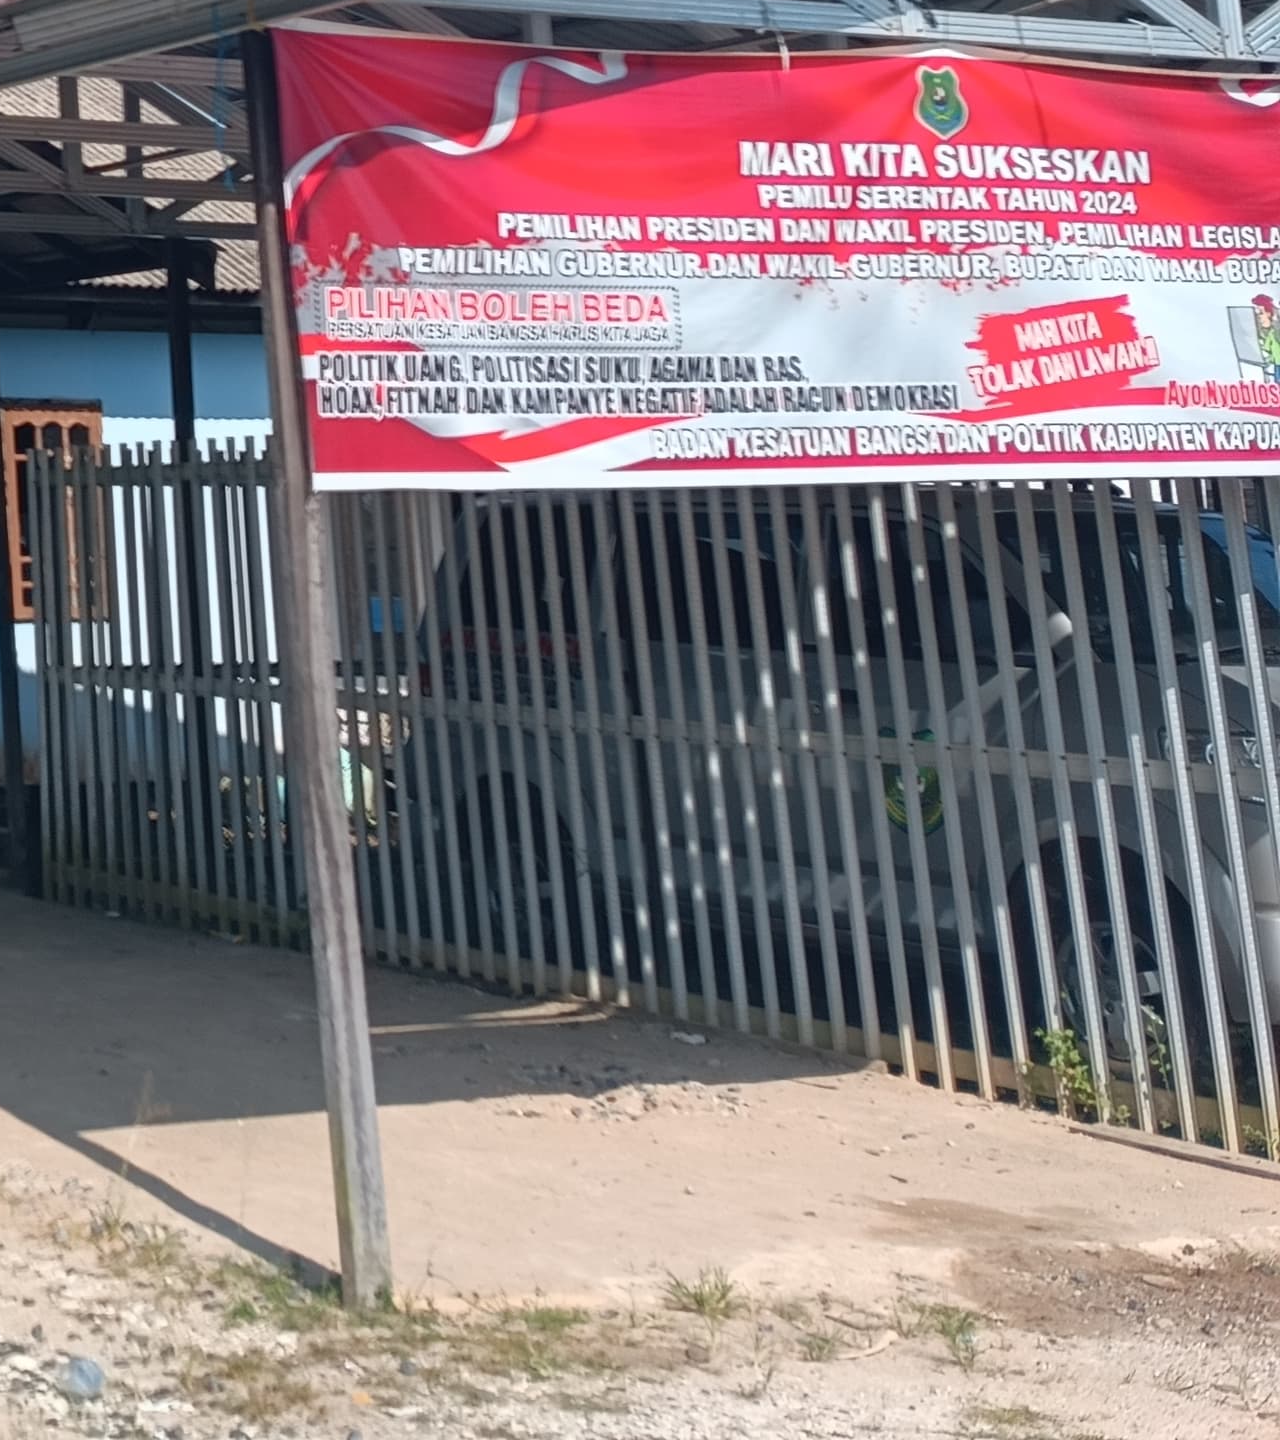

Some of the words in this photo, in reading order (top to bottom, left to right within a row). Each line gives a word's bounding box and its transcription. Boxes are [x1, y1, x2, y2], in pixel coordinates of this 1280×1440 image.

[738, 140, 836, 178] MARI
[840, 142, 929, 180] KITA
[933, 144, 1152, 185] SUKSESKAN
[756, 183, 854, 210] PEMILU
[855, 185, 991, 211] SERENTAK
[992, 187, 1078, 214] TAHUN
[1079, 190, 1138, 216] 2024
[496, 212, 642, 242] PEMILIHAN
[645, 216, 776, 243] PRESIDEN
[779, 217, 831, 243] DAN
[833, 218, 917, 244] WAKIL
[919, 219, 1055, 250] PRESIDEN,
[1058, 220, 1184, 249] PEMILIHAN
[397, 246, 552, 277] PEMILIHAN
[555, 249, 705, 279] GUBERNUR
[706, 252, 761, 279] DAN
[763, 253, 847, 280] WAKIL
[848, 253, 1001, 283] GUBERNUR,
[1006, 254, 1092, 281] BUPATI
[1094, 255, 1148, 282] DAN
[1147, 257, 1224, 283] WAKIL
[328, 289, 450, 320] PILIHAN
[459, 291, 573, 322] BOLEH
[582, 293, 670, 323] BEDA
[1013, 317, 1062, 353] MARI
[1057, 311, 1103, 345] KITA
[319, 353, 398, 382] POLITIK
[404, 354, 469, 384] UANG,
[471, 355, 580, 383] POLITISASI
[584, 355, 646, 386] SUKU,
[648, 355, 717, 383] AGAMA
[719, 355, 758, 383] DAN
[966, 357, 1040, 397] TOLAK
[1038, 350, 1079, 385] DAN
[320, 386, 384, 418] HOAX,
[386, 386, 459, 414] FITNAH
[466, 386, 507, 414] DAN
[510, 387, 617, 415] KAMPANYE
[703, 386, 779, 414] ADALAH
[781, 385, 848, 413] RACUN
[850, 384, 960, 412] DEMOKRASI
[1167, 380, 1201, 409] Ayo
[650, 428, 729, 460] BADAN
[733, 426, 852, 458] KESATUAN
[855, 424, 942, 457] BANGSA
[943, 423, 991, 454] DAN
[997, 422, 1088, 453] POLITIK
[1090, 422, 1211, 452] KABUPATEN
